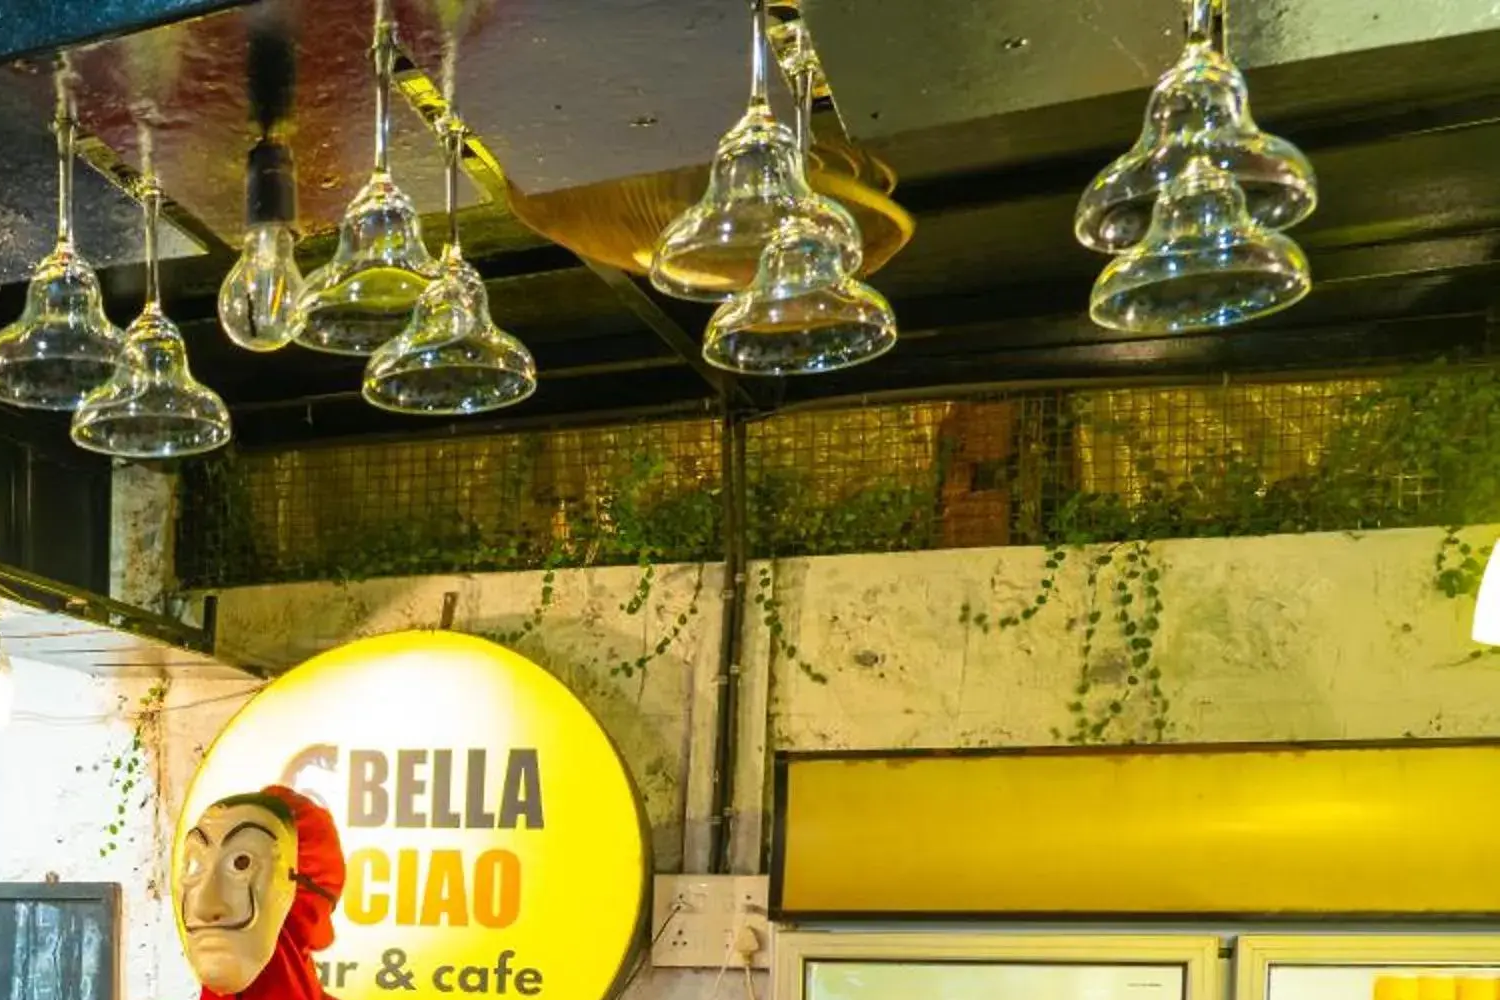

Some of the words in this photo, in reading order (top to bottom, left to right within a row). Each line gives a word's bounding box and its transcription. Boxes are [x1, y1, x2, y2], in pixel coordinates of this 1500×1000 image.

[346, 748, 544, 829] BELLA
[344, 848, 521, 929] CIAO
[375, 947, 417, 990] &
[432, 949, 543, 996] cafe
